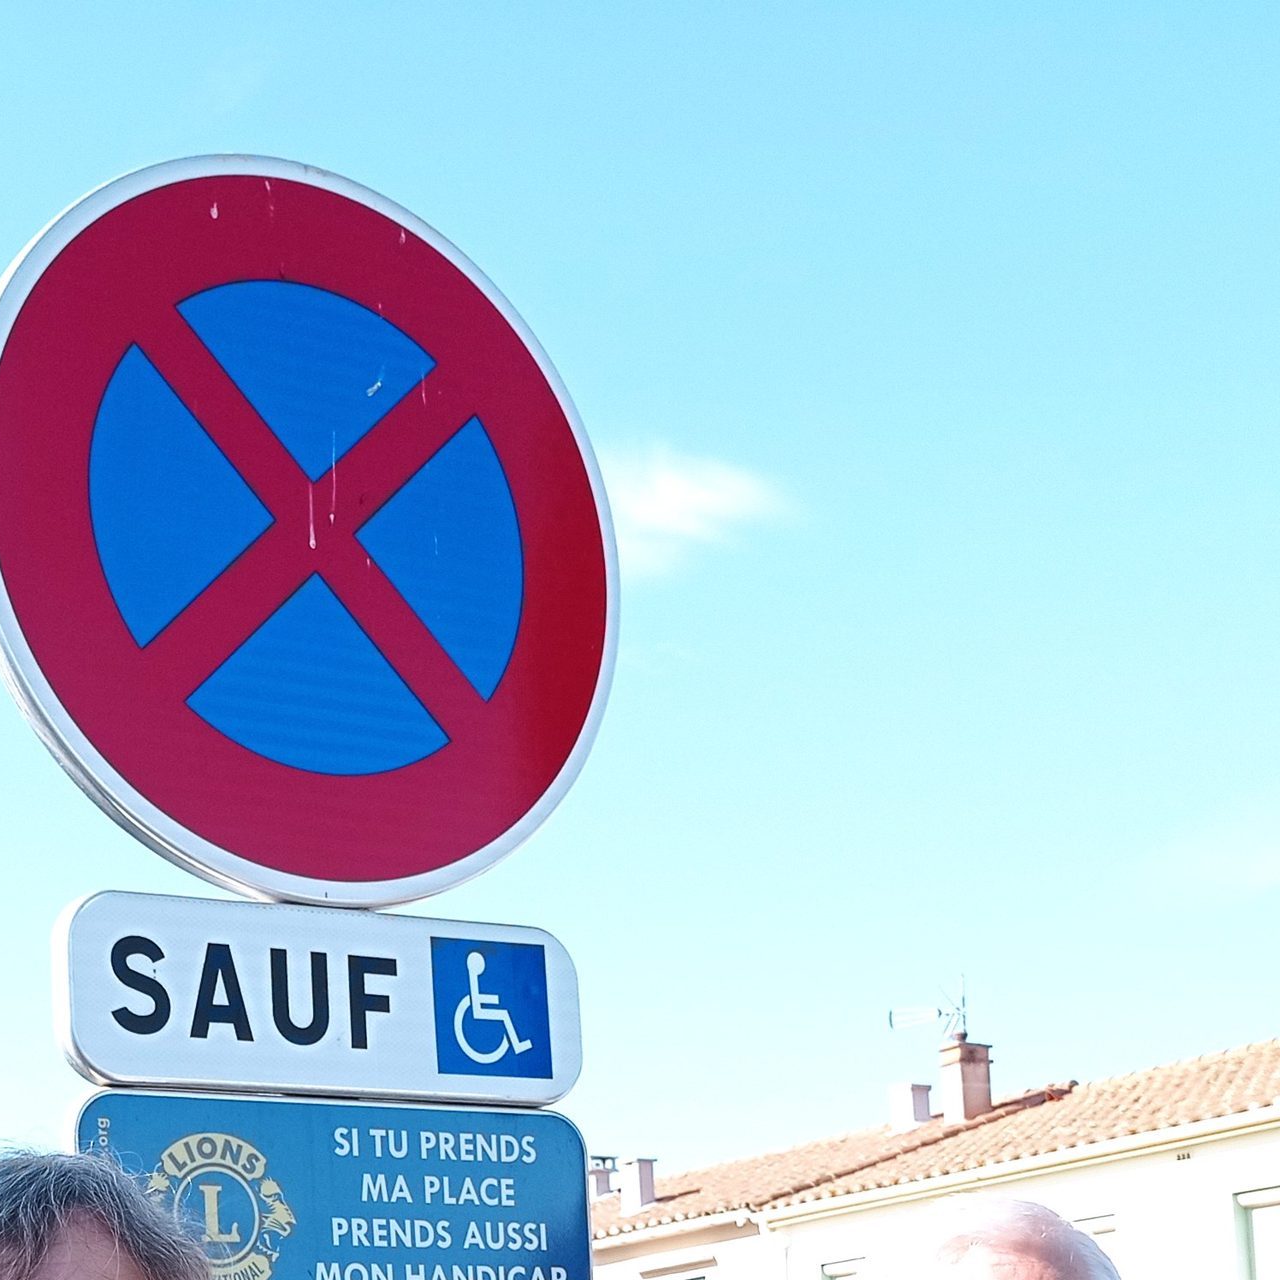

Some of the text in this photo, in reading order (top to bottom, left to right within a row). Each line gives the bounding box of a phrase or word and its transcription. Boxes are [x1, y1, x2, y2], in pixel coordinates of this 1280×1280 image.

[110, 935, 397, 1049] SAUF
[167, 1137, 261, 1175] LIONS
[333, 1127, 537, 1164] SI TU PRENDS
[361, 1173, 515, 1207] MA PLACE
[200, 1185, 241, 1243] L
[331, 1217, 547, 1251] PRENDS AUSSI
